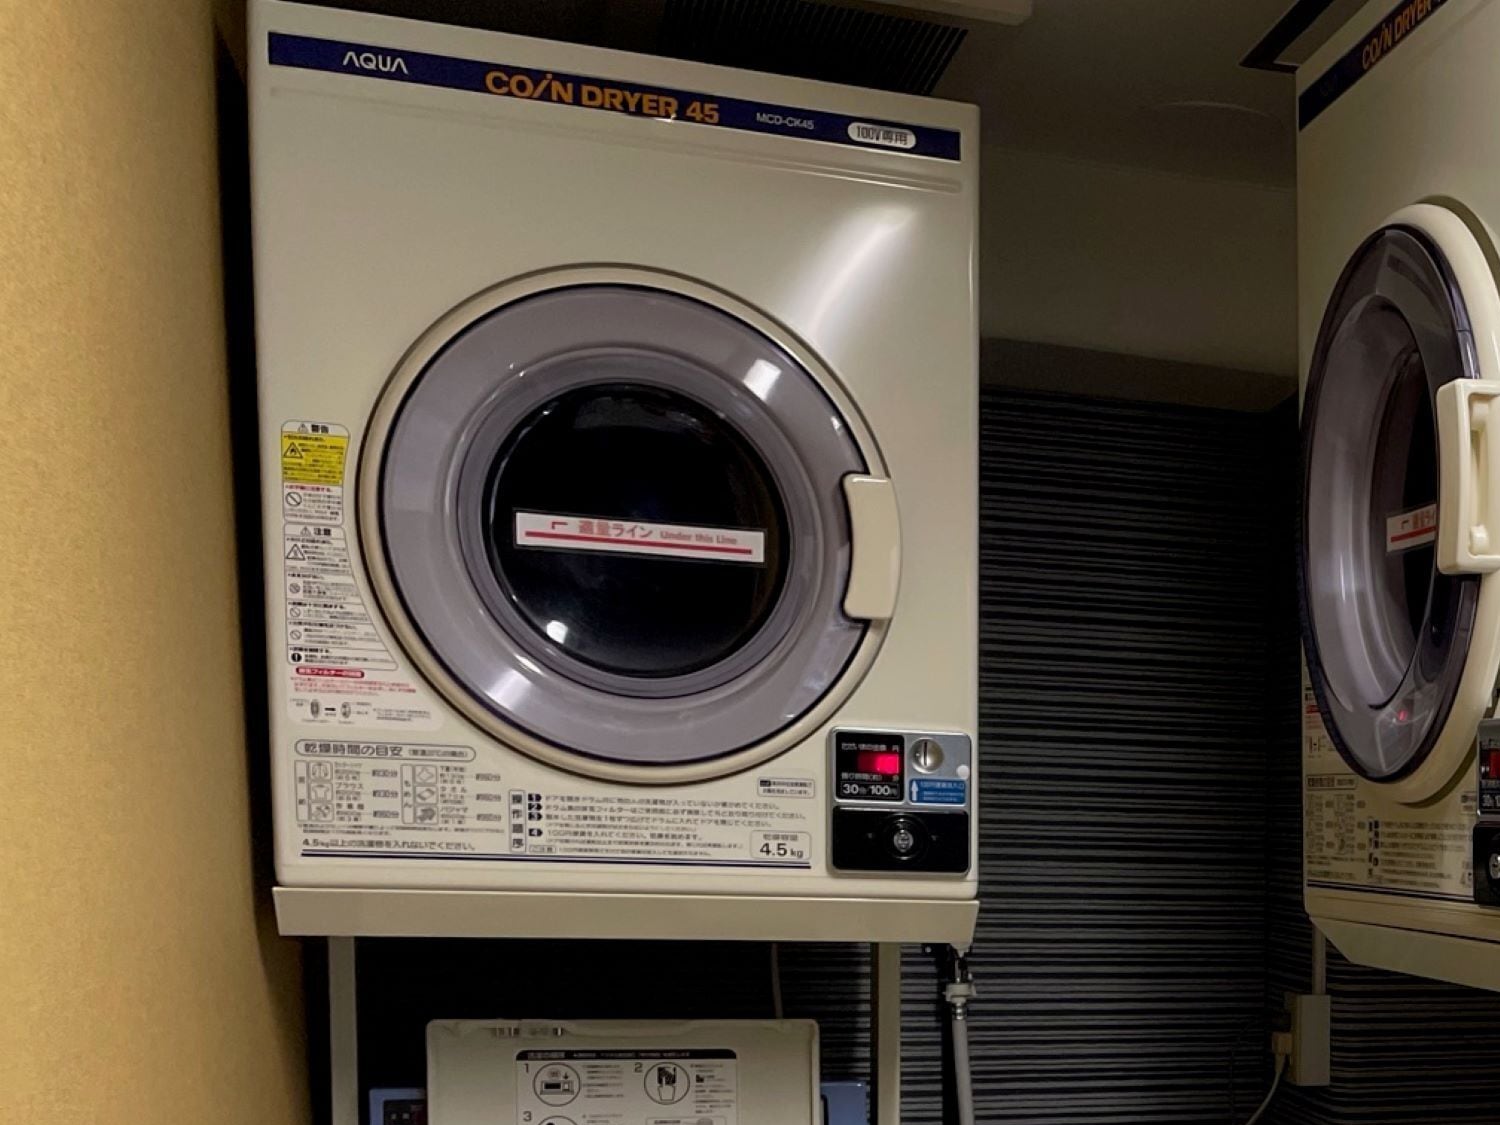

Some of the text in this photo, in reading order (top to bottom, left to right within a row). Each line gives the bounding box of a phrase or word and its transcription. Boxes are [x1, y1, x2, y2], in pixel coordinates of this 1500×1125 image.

[343, 50, 409, 75] AQUA
[580, 84, 678, 121] DRYER
[686, 100, 719, 124] 45
[660, 530, 692, 543] Under
[695, 531, 714, 543] this
[716, 532, 738, 545] Line
[759, 842, 804, 859] 4.5 kg
